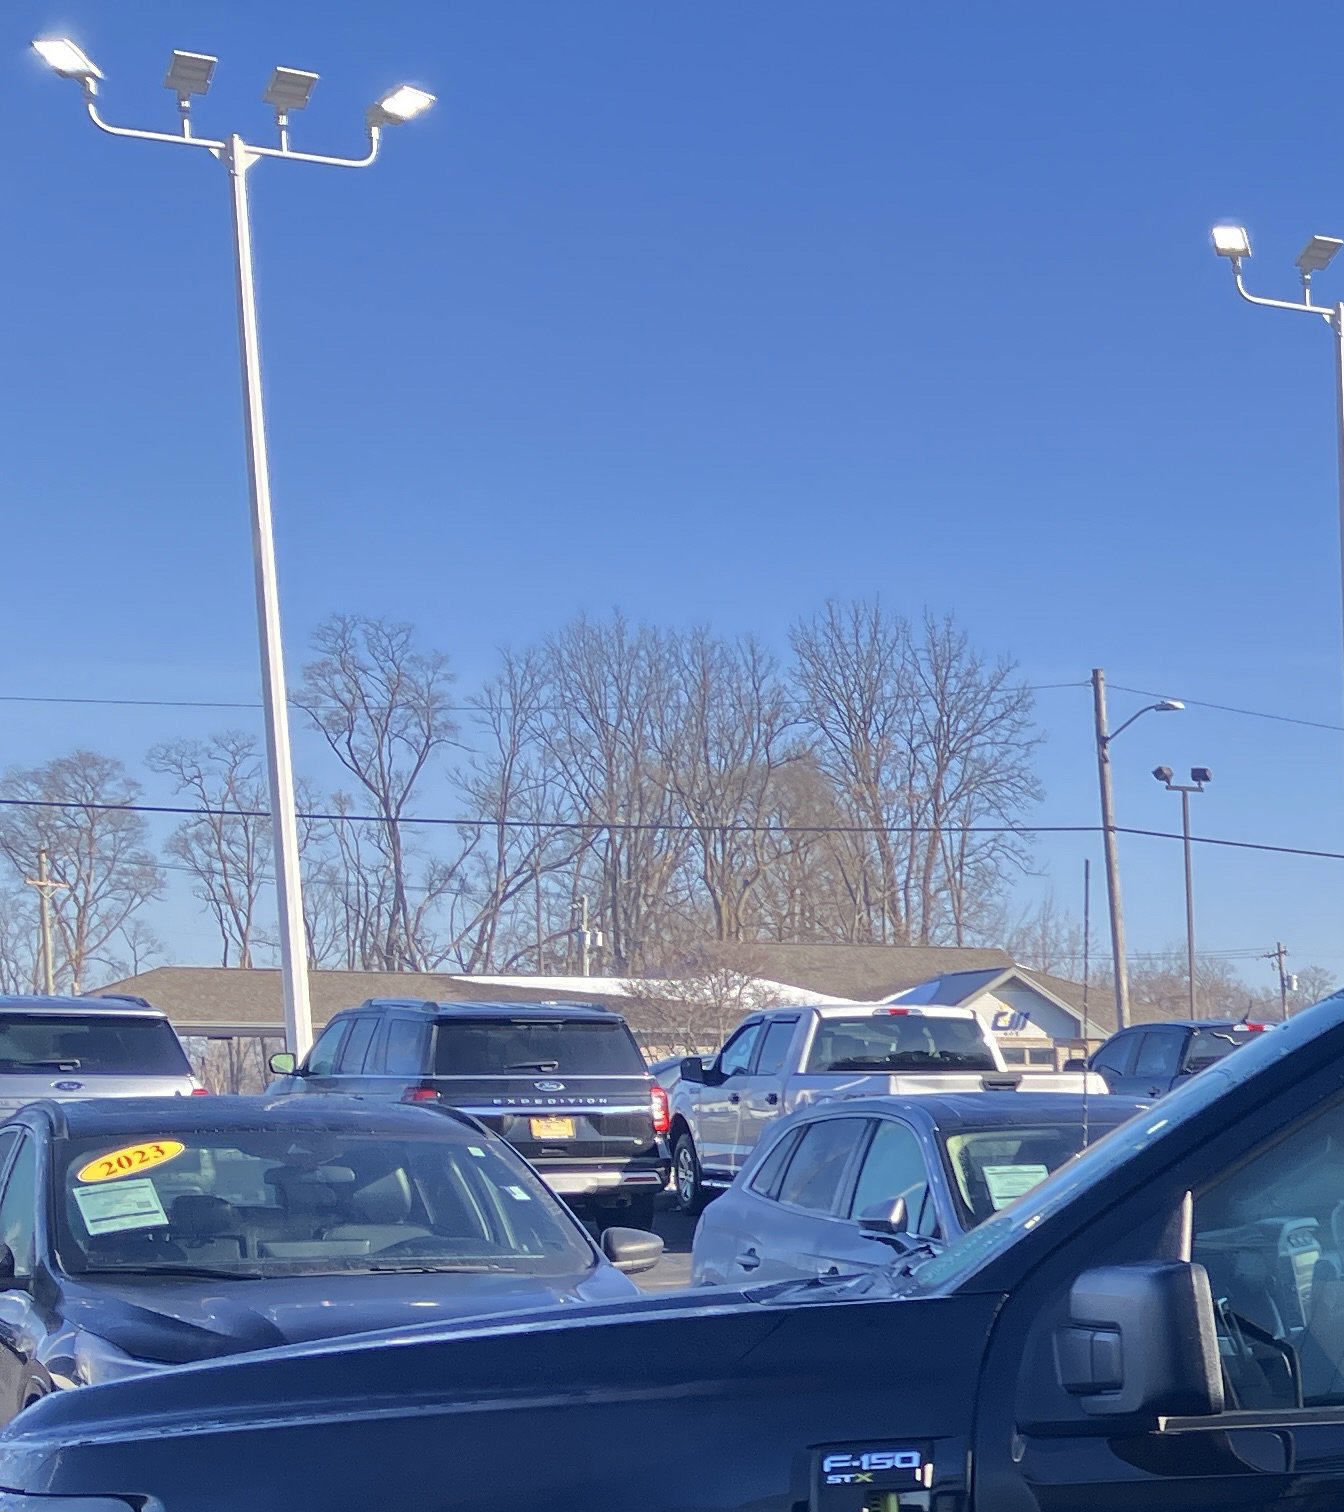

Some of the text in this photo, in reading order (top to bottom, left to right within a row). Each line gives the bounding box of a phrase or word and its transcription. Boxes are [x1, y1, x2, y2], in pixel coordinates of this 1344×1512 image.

[99, 1145, 166, 1176] 2023
[823, 1451, 921, 1472] F-150
[826, 1473, 874, 1484] STX
